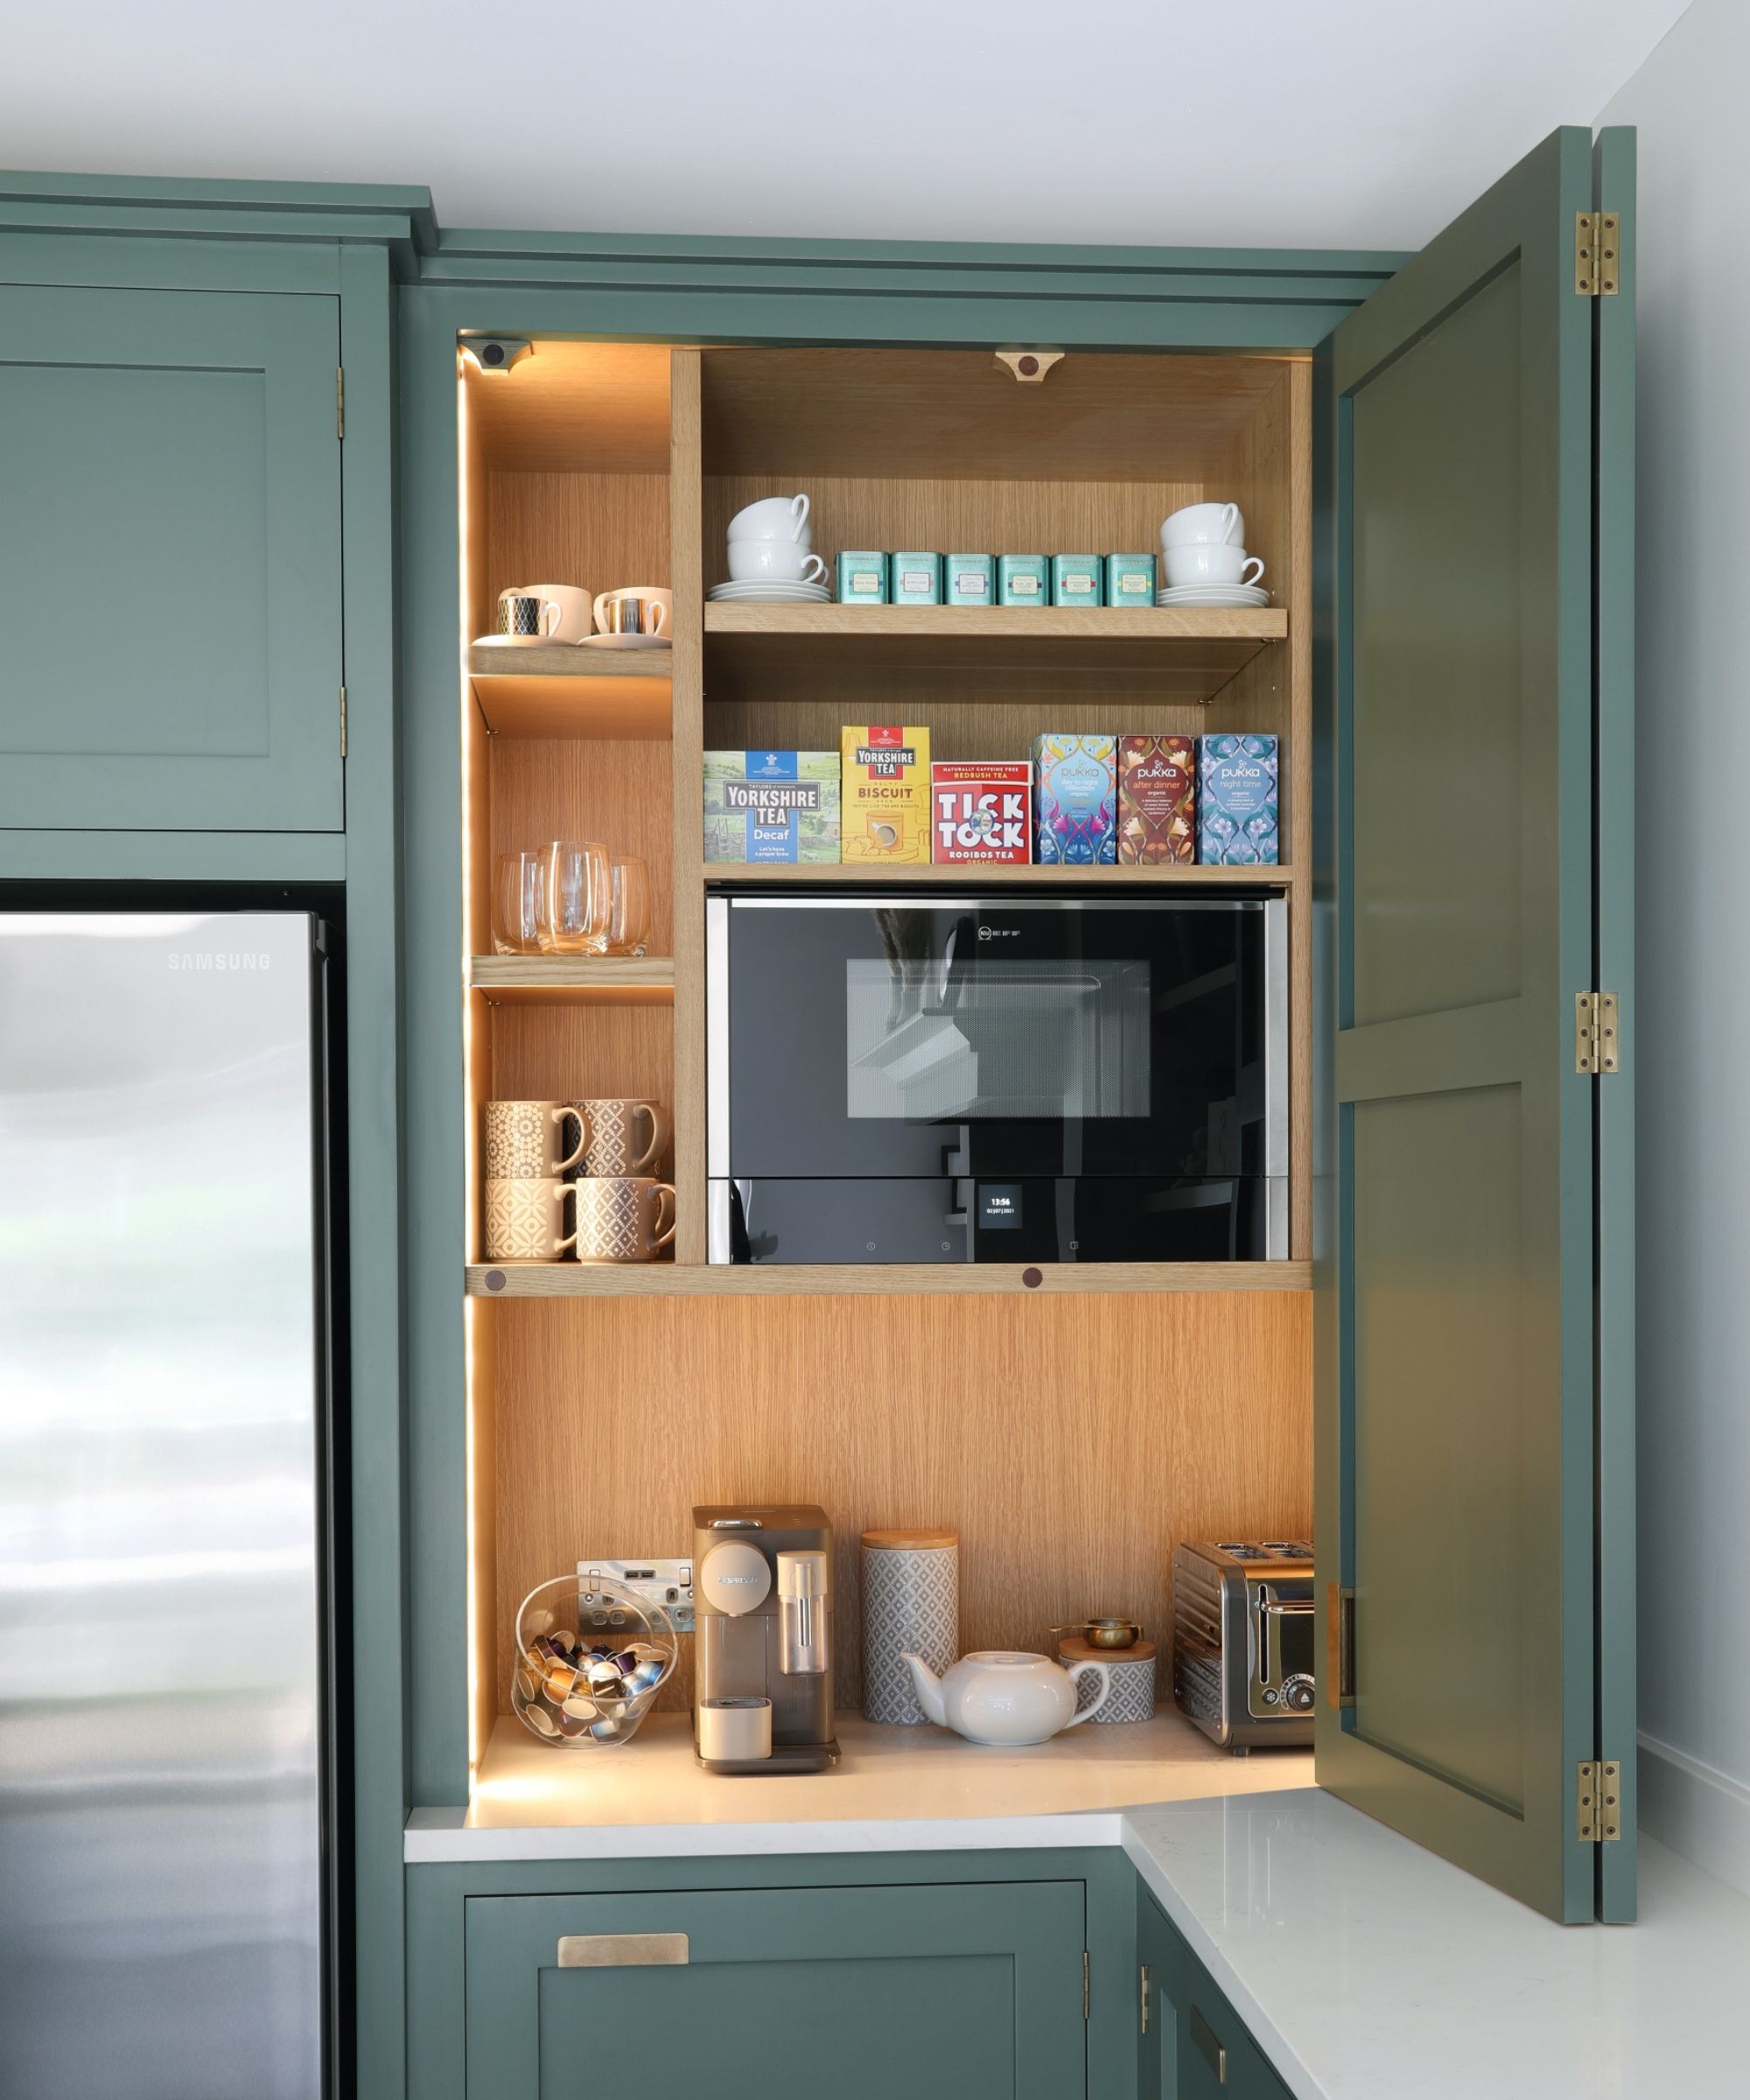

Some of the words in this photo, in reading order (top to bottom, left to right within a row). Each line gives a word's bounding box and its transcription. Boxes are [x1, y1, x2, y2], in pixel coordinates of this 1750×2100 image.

[858, 750, 914, 763] YORKSHIRE
[876, 763, 895, 774] TEA
[1060, 768, 1099, 778] pukka
[1138, 768, 1177, 780] pukka
[1222, 768, 1260, 780] pukka
[728, 786, 816, 808] YORKSHIRE
[858, 788, 914, 799] BISCUIT
[938, 794, 1024, 819] TICK
[757, 808, 787, 824] TEA
[753, 829, 790, 840] Decaf
[938, 822, 1024, 848] TOCK
[949, 850, 993, 859] ROOIBOS
[995, 850, 1014, 859] TEA
[167, 952, 271, 970] SAMSUNG
